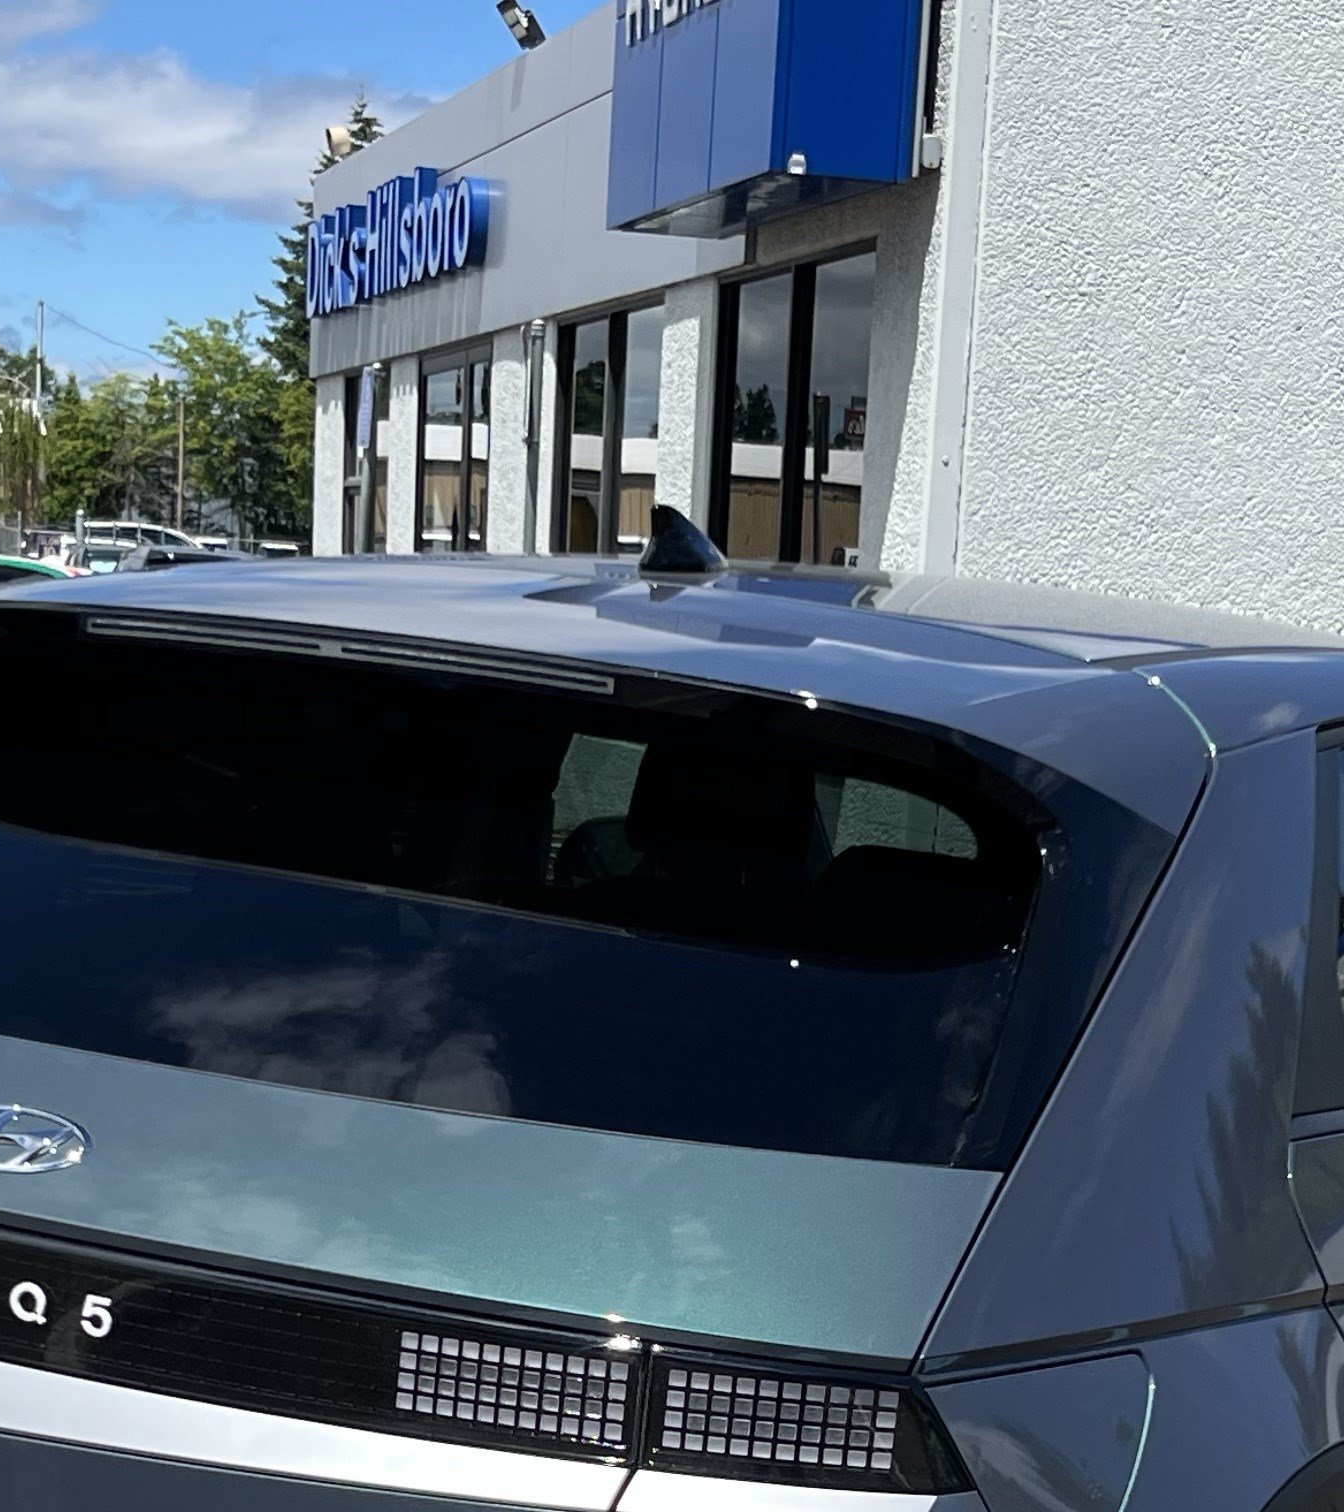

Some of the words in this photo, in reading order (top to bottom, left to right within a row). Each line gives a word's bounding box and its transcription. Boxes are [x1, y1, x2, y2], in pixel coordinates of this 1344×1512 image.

[306, 205, 360, 319] Dick's
[364, 167, 474, 300] Hillsboro
[80, 1294, 114, 1339] 5
